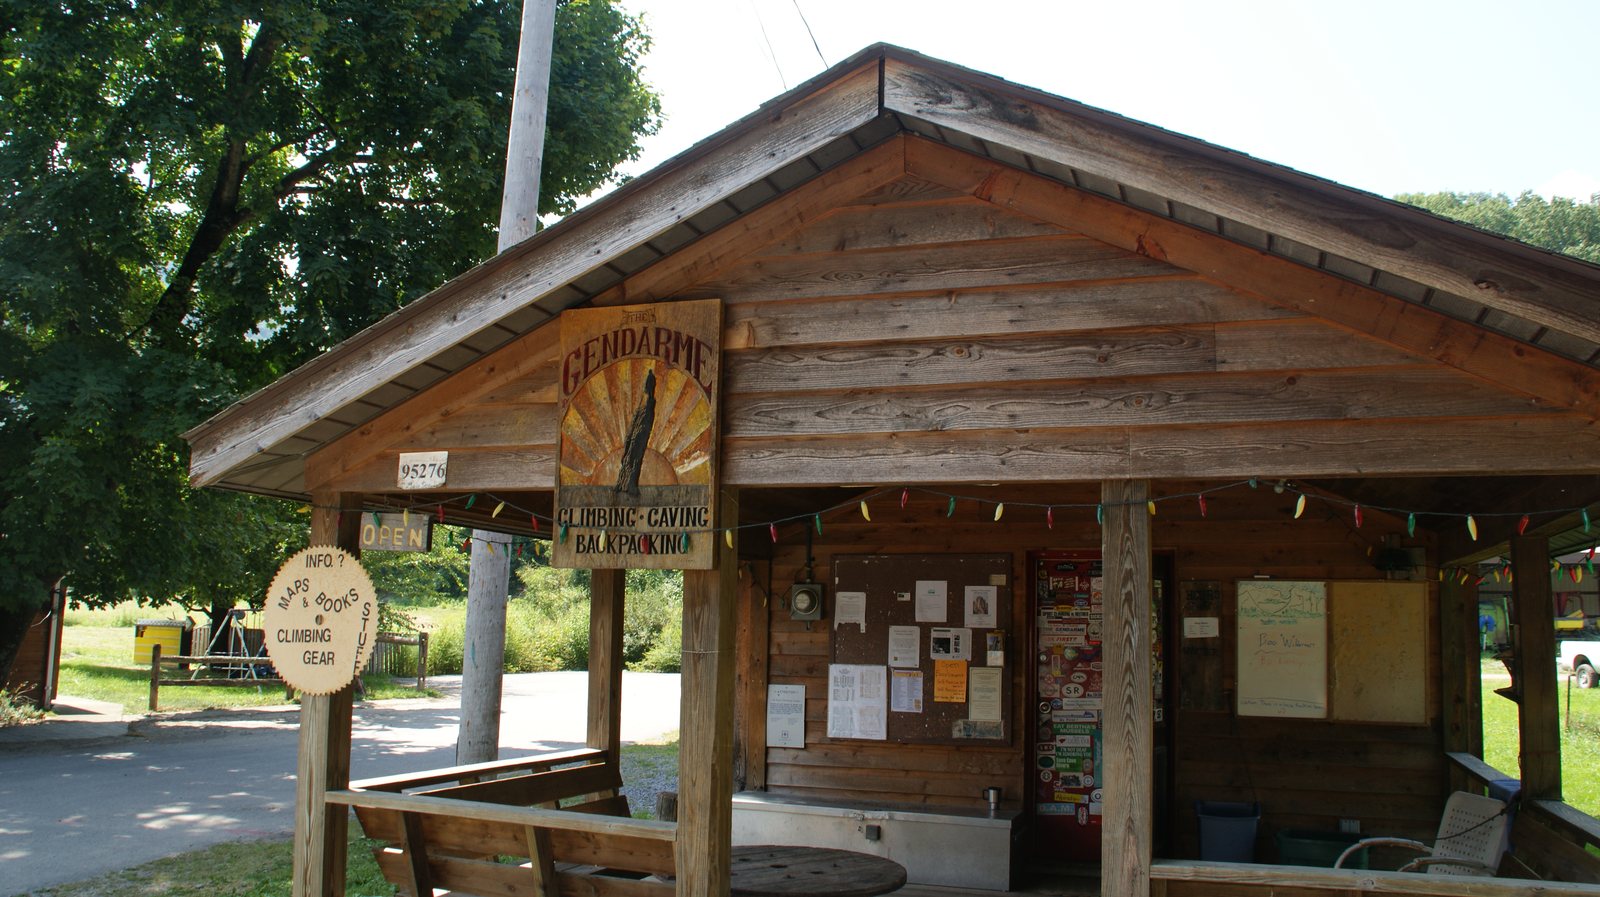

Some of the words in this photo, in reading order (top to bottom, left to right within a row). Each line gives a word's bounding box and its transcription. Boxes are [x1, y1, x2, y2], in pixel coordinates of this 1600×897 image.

[629, 312, 649, 323] THE
[562, 326, 714, 405] GENDARME
[401, 463, 447, 479] 95276
[557, 507, 636, 528] CLIMBING
[647, 506, 710, 528] CAVING
[362, 523, 423, 548] OPEN
[305, 553, 333, 568] INFO.
[278, 578, 310, 611] MAPS
[302, 596, 309, 608] &
[315, 588, 359, 613] BOOKS
[277, 627, 332, 643] CLIMBING
[353, 601, 371, 675] STUFF
[303, 650, 335, 666] GEAR
